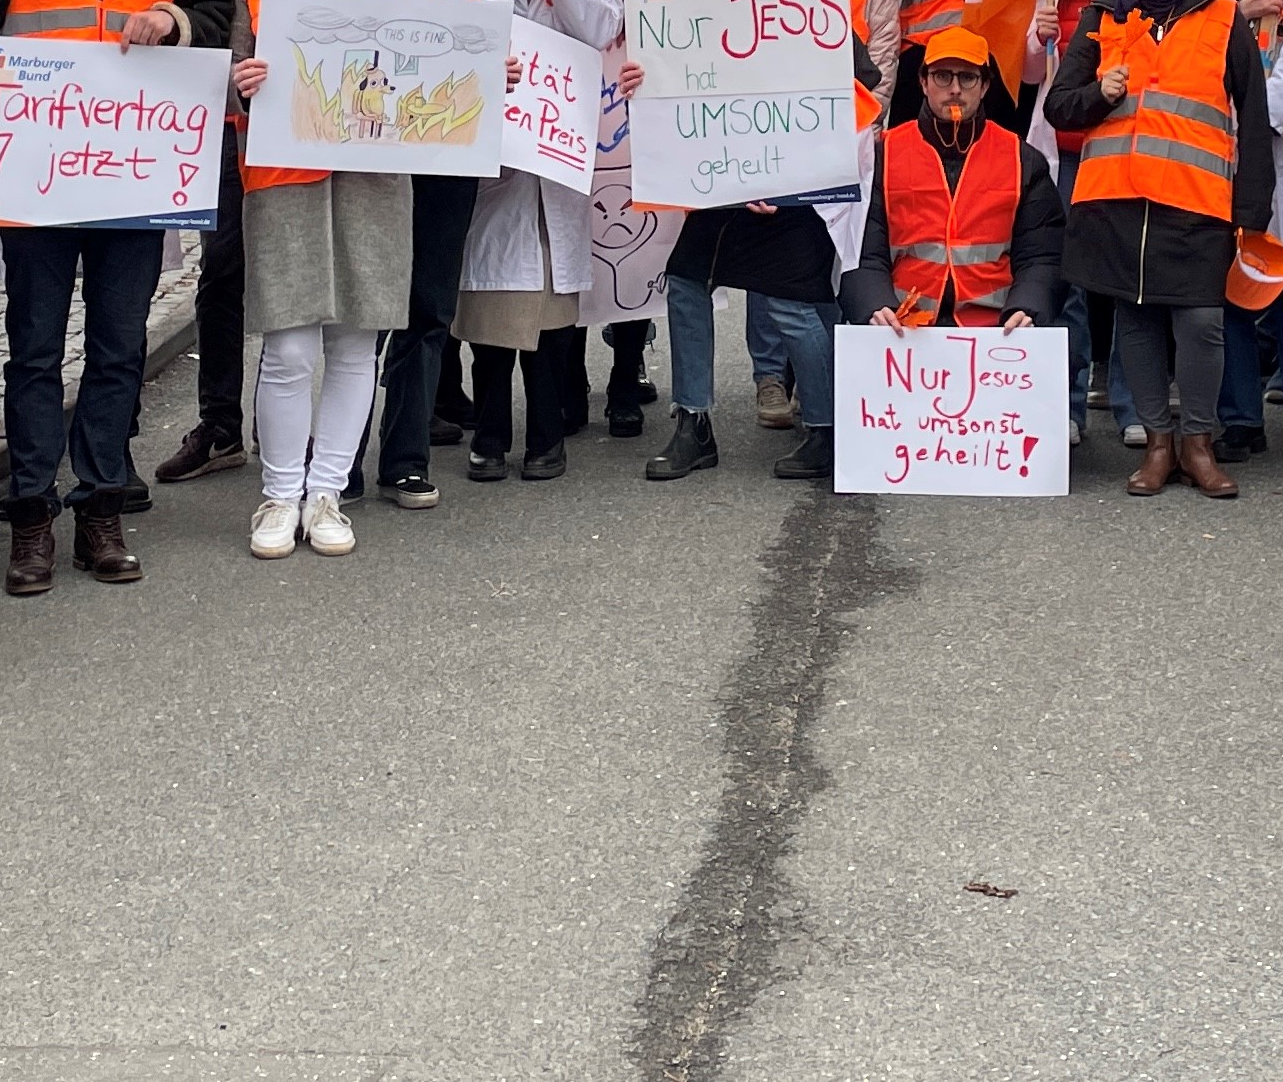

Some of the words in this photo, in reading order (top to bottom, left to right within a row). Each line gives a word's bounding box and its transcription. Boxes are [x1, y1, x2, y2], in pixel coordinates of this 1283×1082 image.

[384, 27, 405, 41] THIS
[409, 29, 420, 42] IS
[424, 31, 448, 45] FINE
[639, 5, 714, 50] Nur
[8, 55, 76, 71] Marburger
[18, 69, 51, 82] Bund
[685, 62, 718, 91] hat
[504, 102, 532, 131] en
[537, 97, 587, 153] Preis
[676, 96, 851, 139] UMSONST
[37, 140, 157, 196] jetzt
[691, 146, 785, 194] geheilt
[885, 347, 951, 393] Nur
[932, 335, 1034, 419] Jesus
[861, 397, 902, 430] hat
[918, 412, 1024, 436] umsonst
[884, 435, 1040, 484] geheilt!
